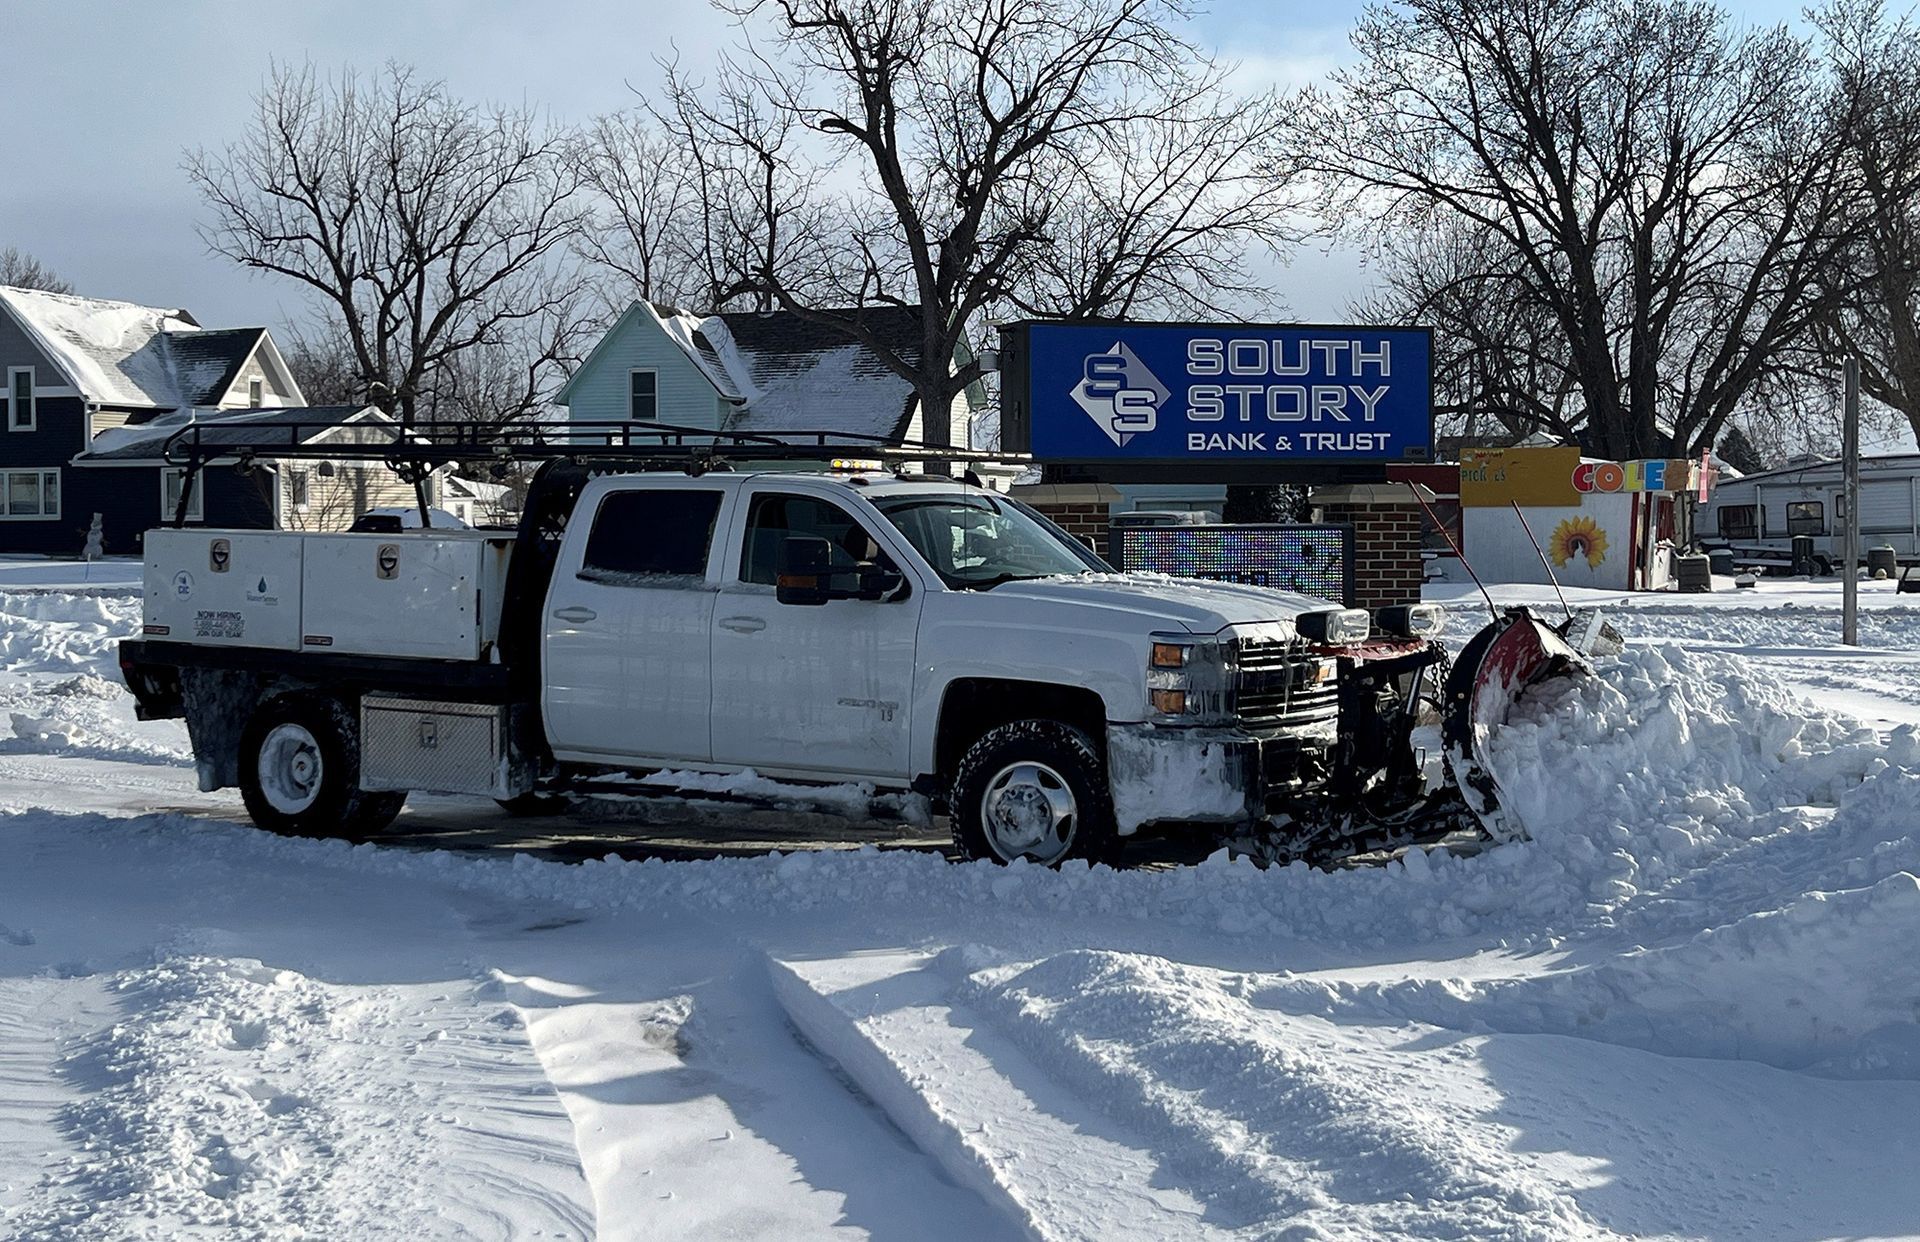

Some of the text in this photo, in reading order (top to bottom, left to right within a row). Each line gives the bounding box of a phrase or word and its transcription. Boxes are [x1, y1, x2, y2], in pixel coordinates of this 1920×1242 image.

[1187, 339, 1391, 376] SOUTH
[1187, 385, 1390, 421] STORY
[1188, 433, 1391, 450] BANK & TRUST
[197, 610, 242, 621] NOW HIRING
[211, 630, 224, 638] OUR
[225, 630, 242, 638] TEAM
[881, 709, 893, 721] 19
